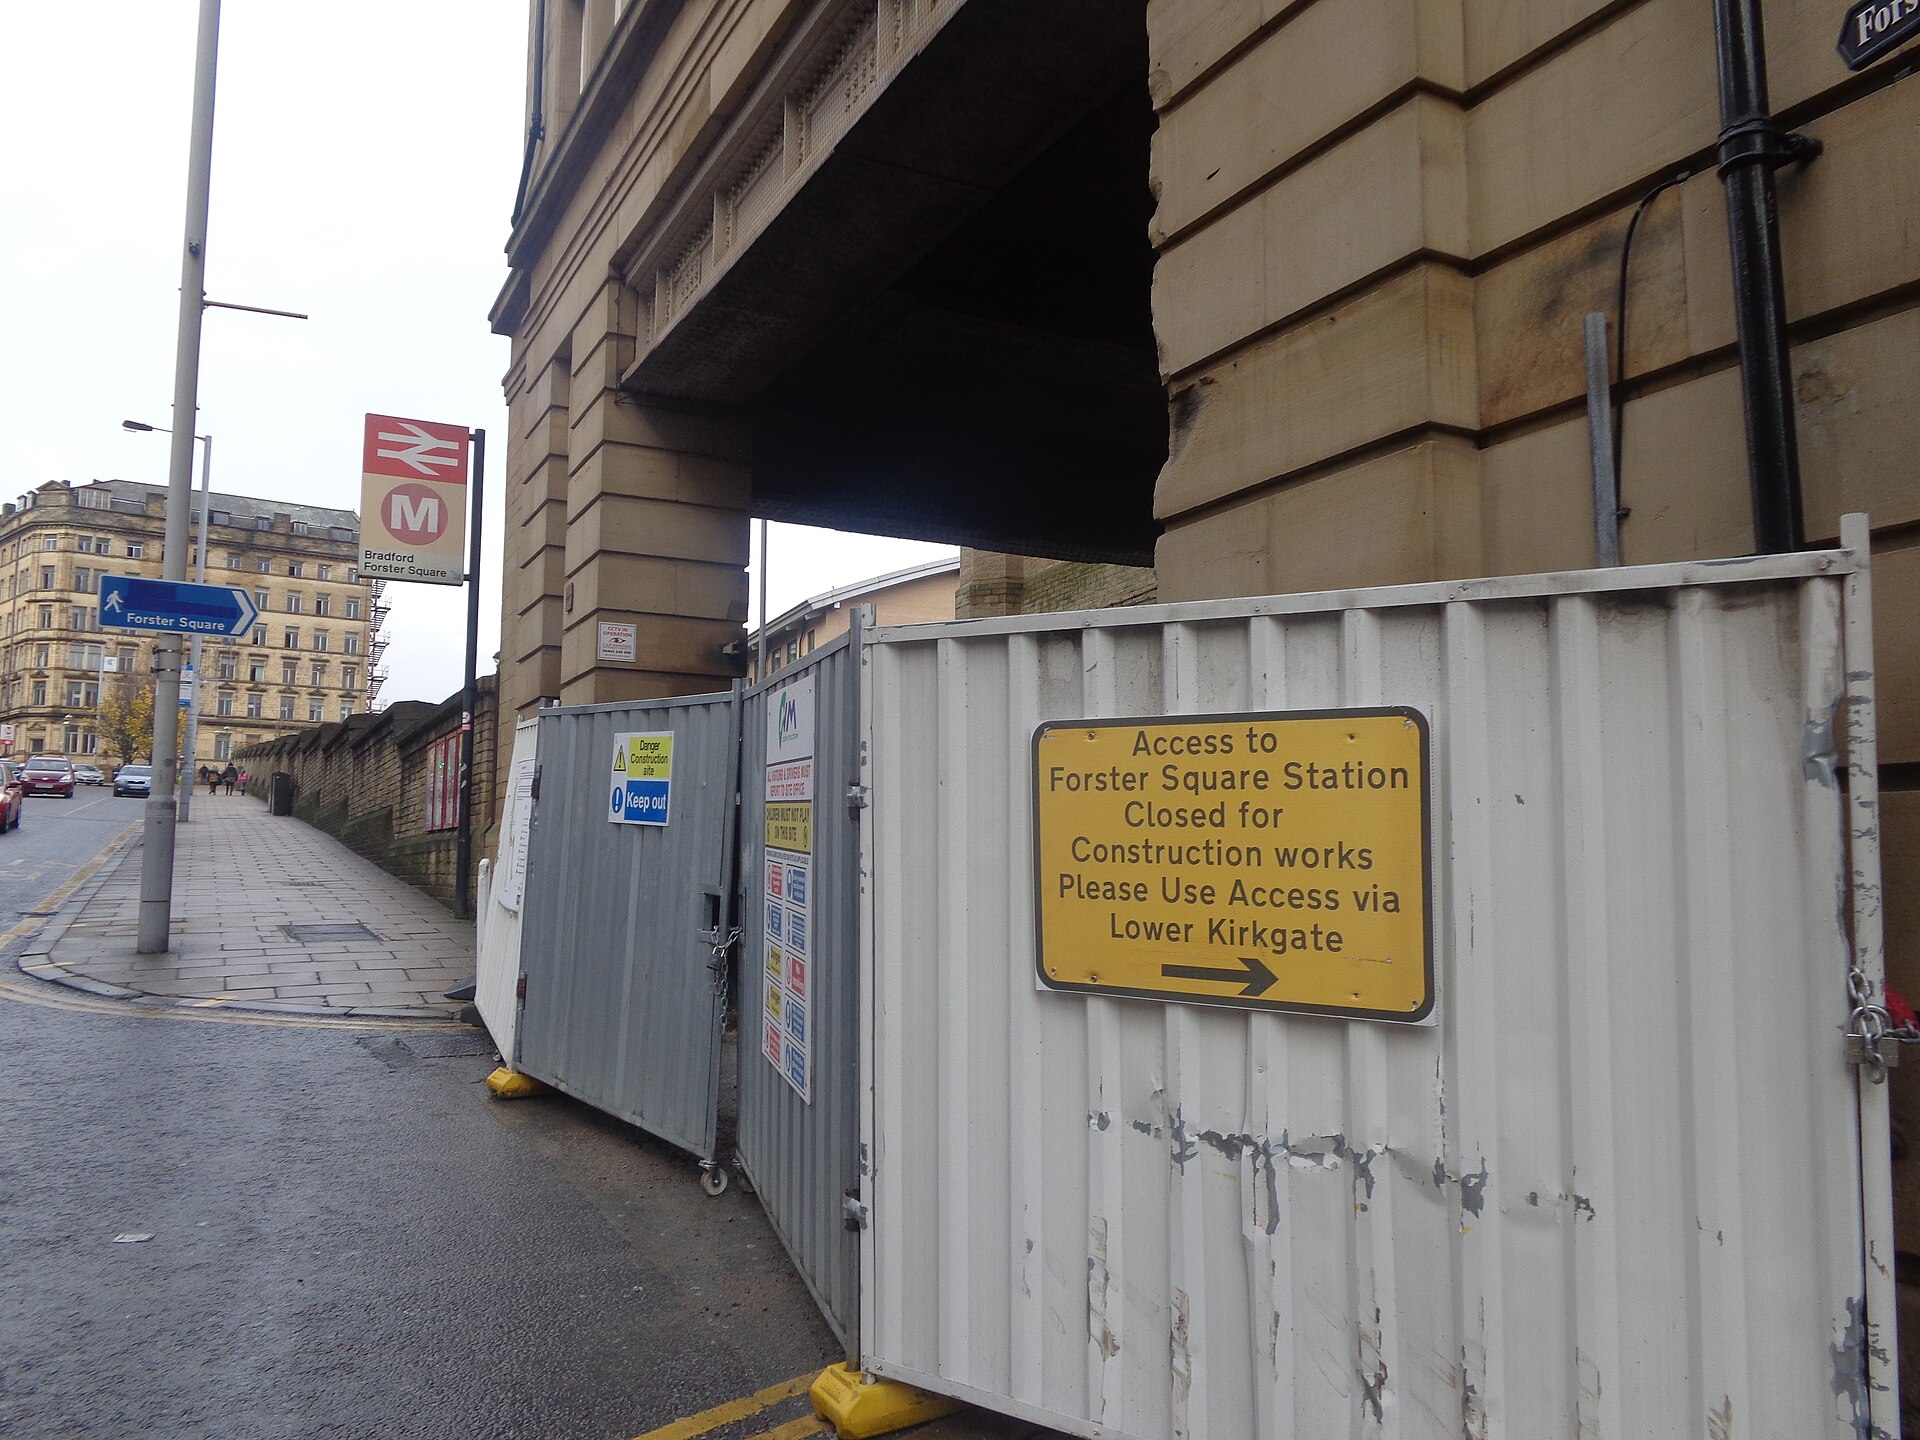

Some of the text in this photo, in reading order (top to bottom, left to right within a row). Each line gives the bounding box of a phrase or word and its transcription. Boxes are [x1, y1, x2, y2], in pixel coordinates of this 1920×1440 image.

[391, 494, 439, 533] M
[365, 550, 414, 563] Bradford
[364, 562, 447, 578] Forster Square
[127, 613, 225, 631] Forster Square
[640, 740, 661, 756] Danger
[1132, 727, 1278, 756] Access to
[630, 754, 668, 764] Construction
[643, 765, 654, 776] site
[1050, 761, 1409, 796] Forster Square Station
[626, 791, 667, 813] Keep out
[800, 808, 810, 822] PLAY
[1124, 801, 1284, 829] Closed for
[1071, 835, 1373, 870] Construction works
[1059, 873, 1400, 913] Please Use Access via
[1111, 913, 1344, 954] Lower Kirkgate
